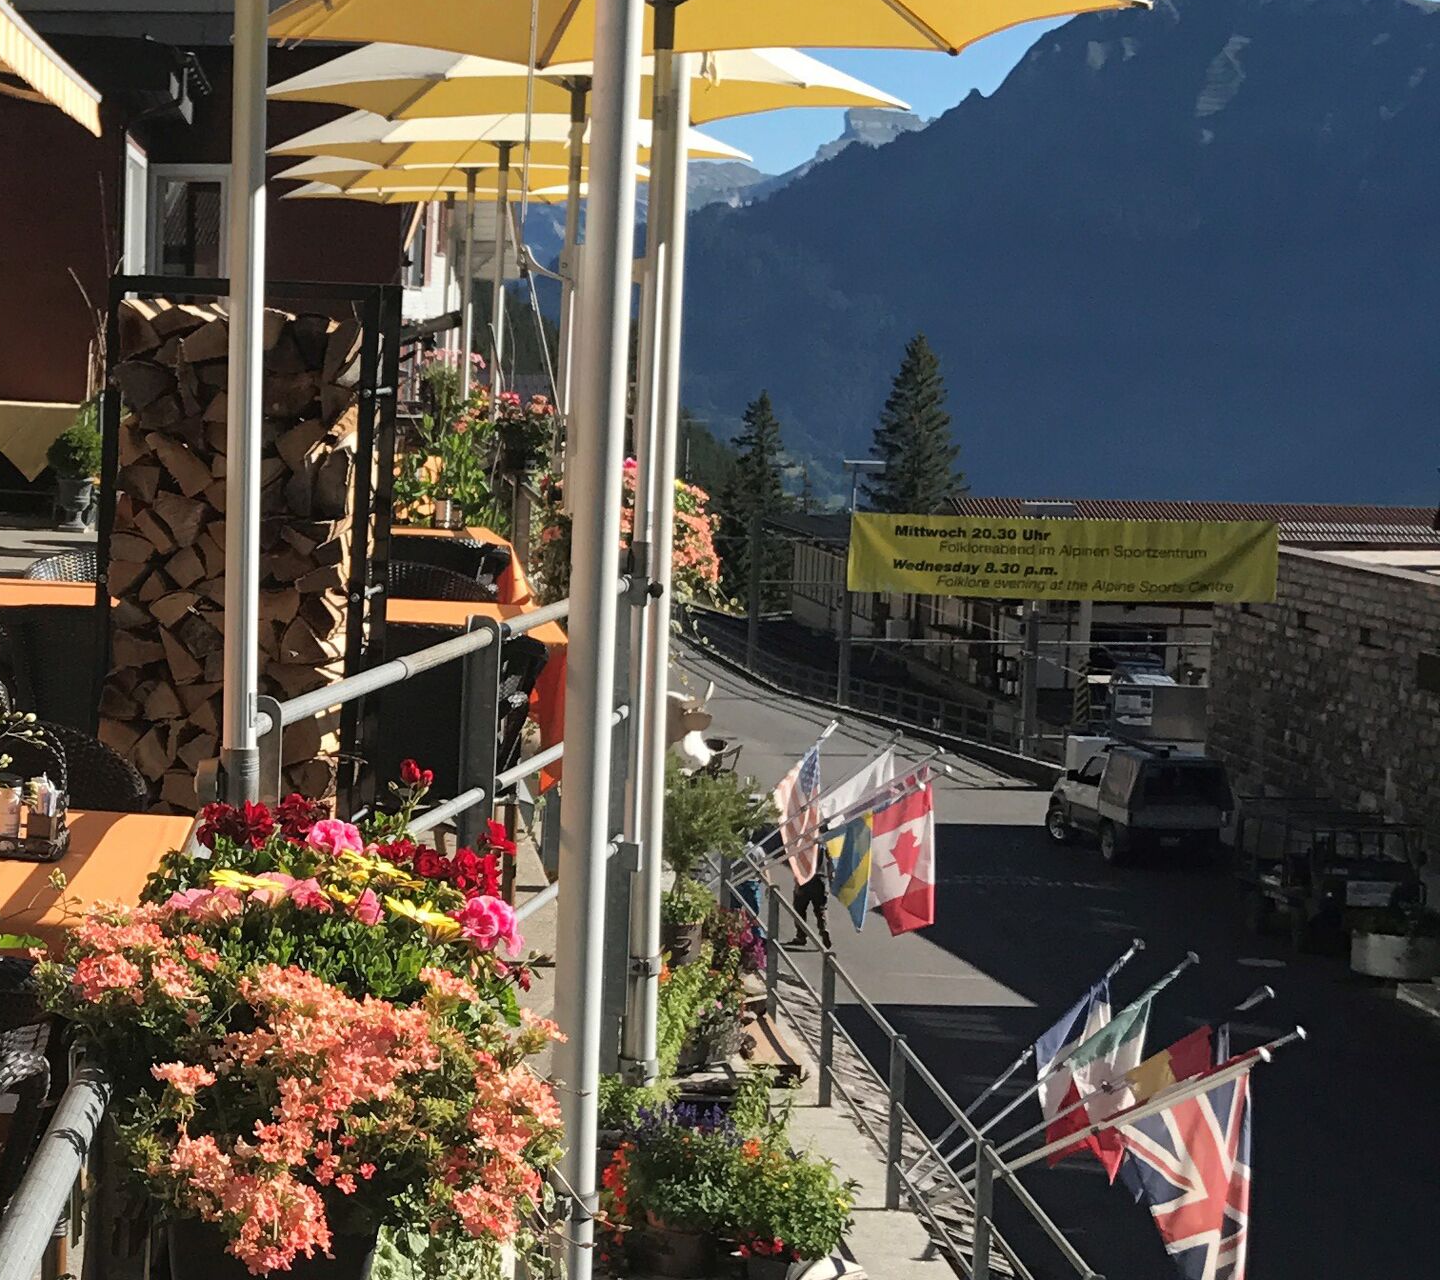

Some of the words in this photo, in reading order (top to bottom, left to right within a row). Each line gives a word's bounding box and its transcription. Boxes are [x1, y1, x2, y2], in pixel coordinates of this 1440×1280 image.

[895, 525, 966, 538] Mittwoch
[972, 528, 1017, 540] 20.30
[1023, 529, 1051, 541] Uhr
[939, 541, 1035, 556] Folkloreabend
[1039, 545, 1055, 556] im
[1059, 545, 1110, 559] Alpinen
[1114, 545, 1207, 560] Sportzentrum
[893, 559, 979, 575] Wednesday
[985, 562, 1020, 574] 8.30
[1024, 565, 1058, 577] p.m.
[936, 575, 990, 588] Folklore
[994, 577, 1045, 592] evening
[1050, 580, 1064, 591] at
[1067, 580, 1088, 591] the
[1092, 580, 1136, 594] Alpine
[1139, 581, 1183, 595] Sports
[1189, 581, 1234, 593] Centre
